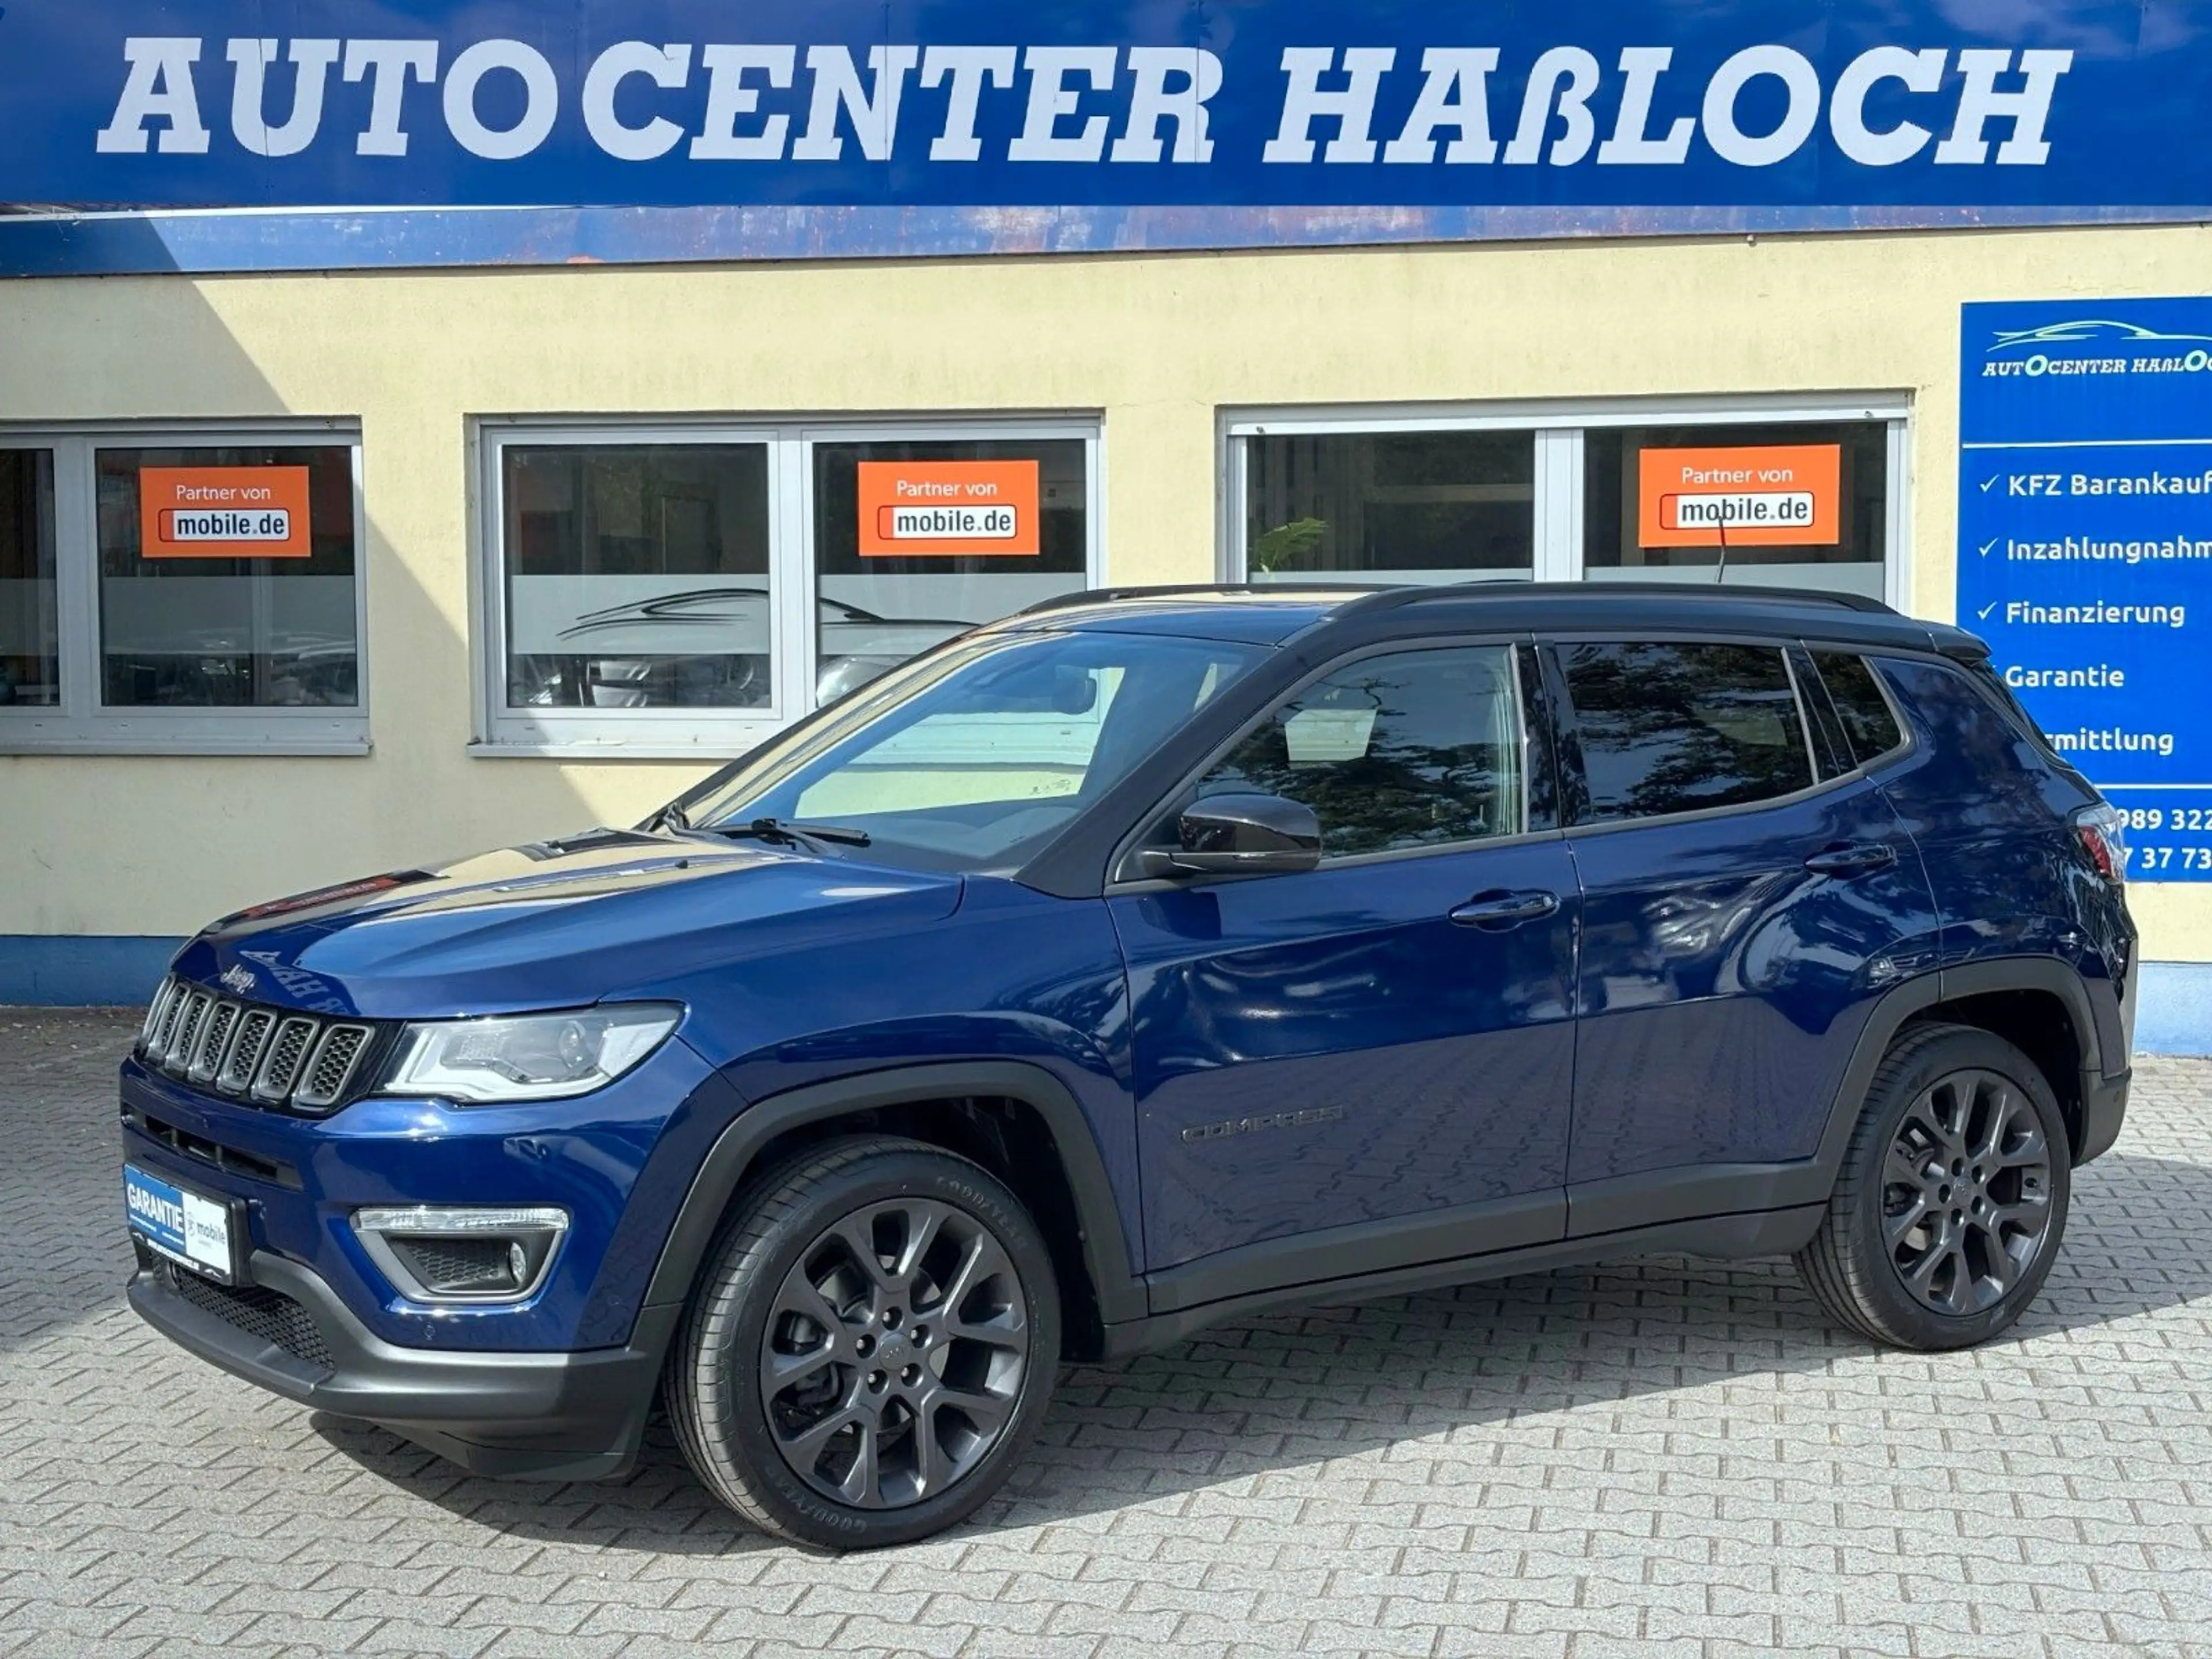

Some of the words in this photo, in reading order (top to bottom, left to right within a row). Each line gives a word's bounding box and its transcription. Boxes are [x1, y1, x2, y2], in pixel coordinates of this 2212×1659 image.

[97, 37, 1222, 162] AUTOCENTER
[1262, 44, 2074, 166] HAßLOCH
[1982, 354, 2127, 376] AUTOCENTER
[1682, 467, 1753, 484] Partner
[1758, 469, 1793, 482] von
[2009, 475, 2062, 496] KFZ
[2071, 470, 2212, 495] Barankauf
[176, 485, 237, 500] Partner
[241, 488, 271, 500] von
[897, 480, 961, 497] Partner
[965, 483, 997, 496] von
[1682, 497, 1808, 522] mobile.de
[177, 513, 285, 535] mobile.de
[897, 510, 1011, 532] mobile.de
[2007, 600, 2185, 627] Finanzierung
[2006, 664, 2124, 687] Garantie
[2141, 847, 2173, 869] 37
[127, 1183, 184, 1234] GARANTIE
